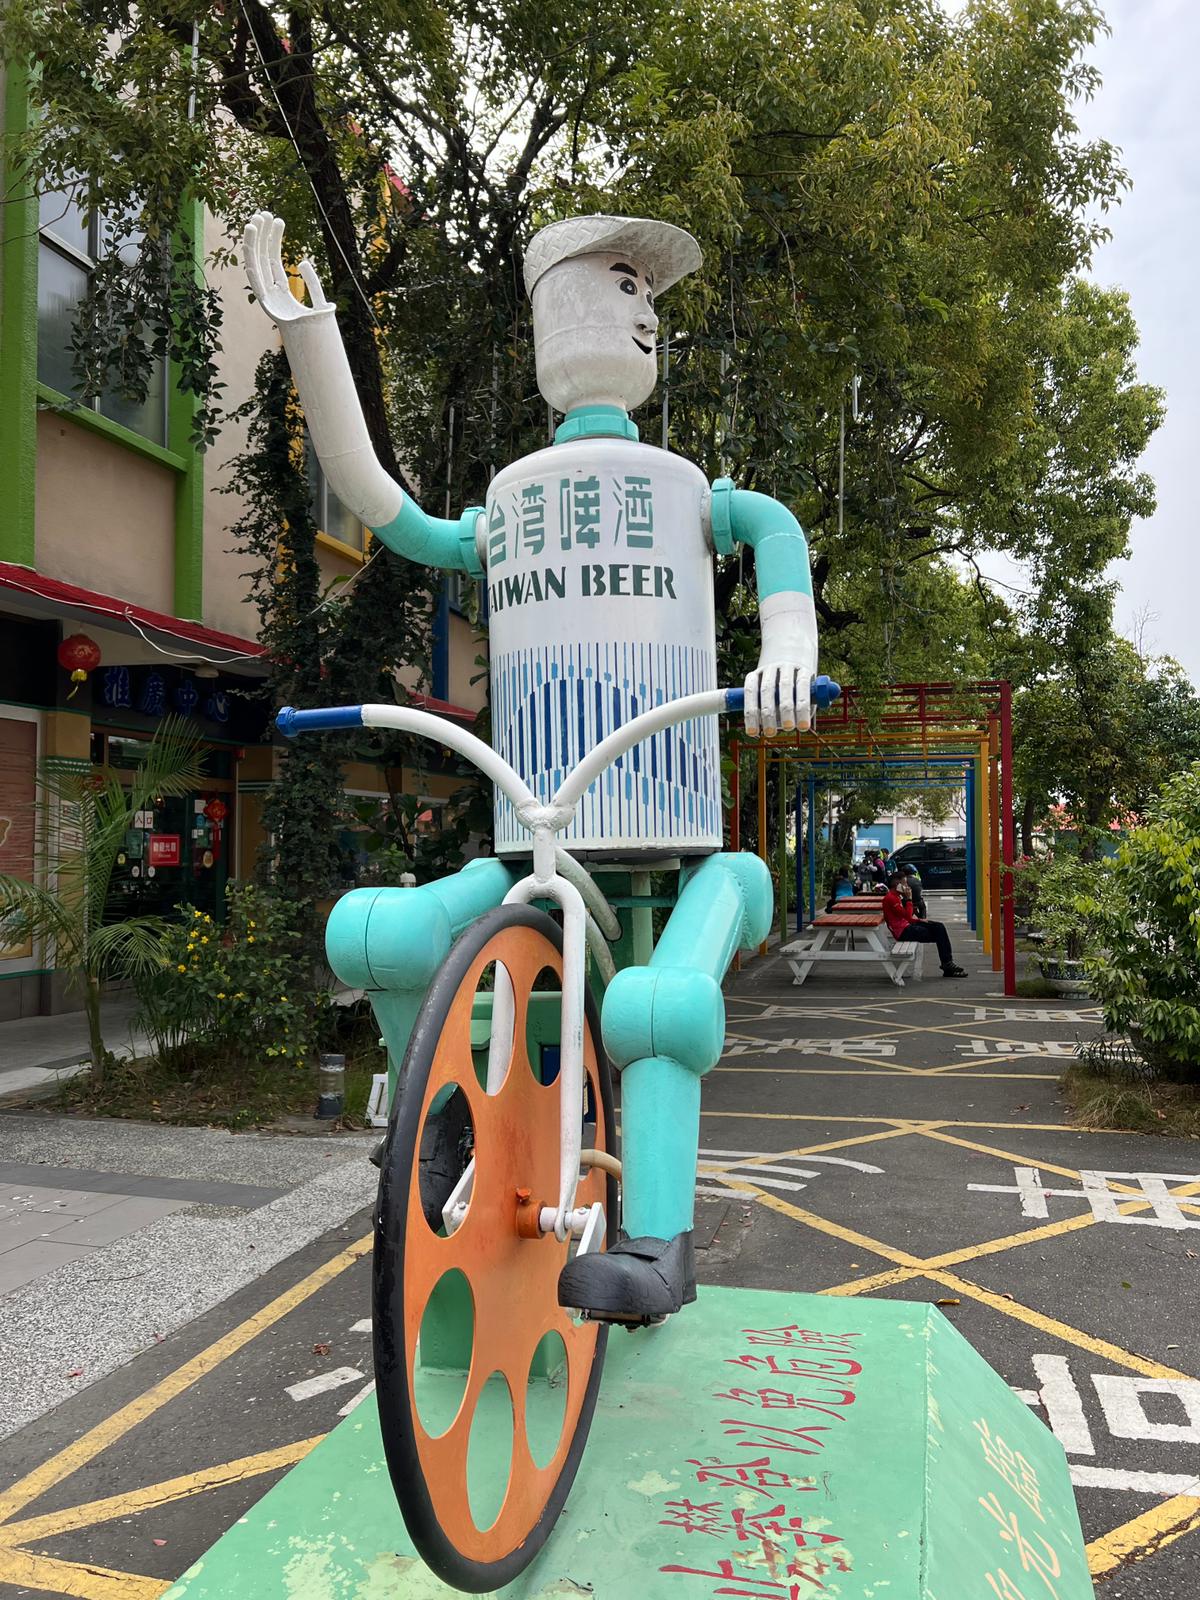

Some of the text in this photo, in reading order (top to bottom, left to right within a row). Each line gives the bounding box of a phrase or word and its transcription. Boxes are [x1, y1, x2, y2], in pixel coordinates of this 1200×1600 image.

[581, 563, 677, 599] BEER
[104, 666, 230, 722] 推廣中心
